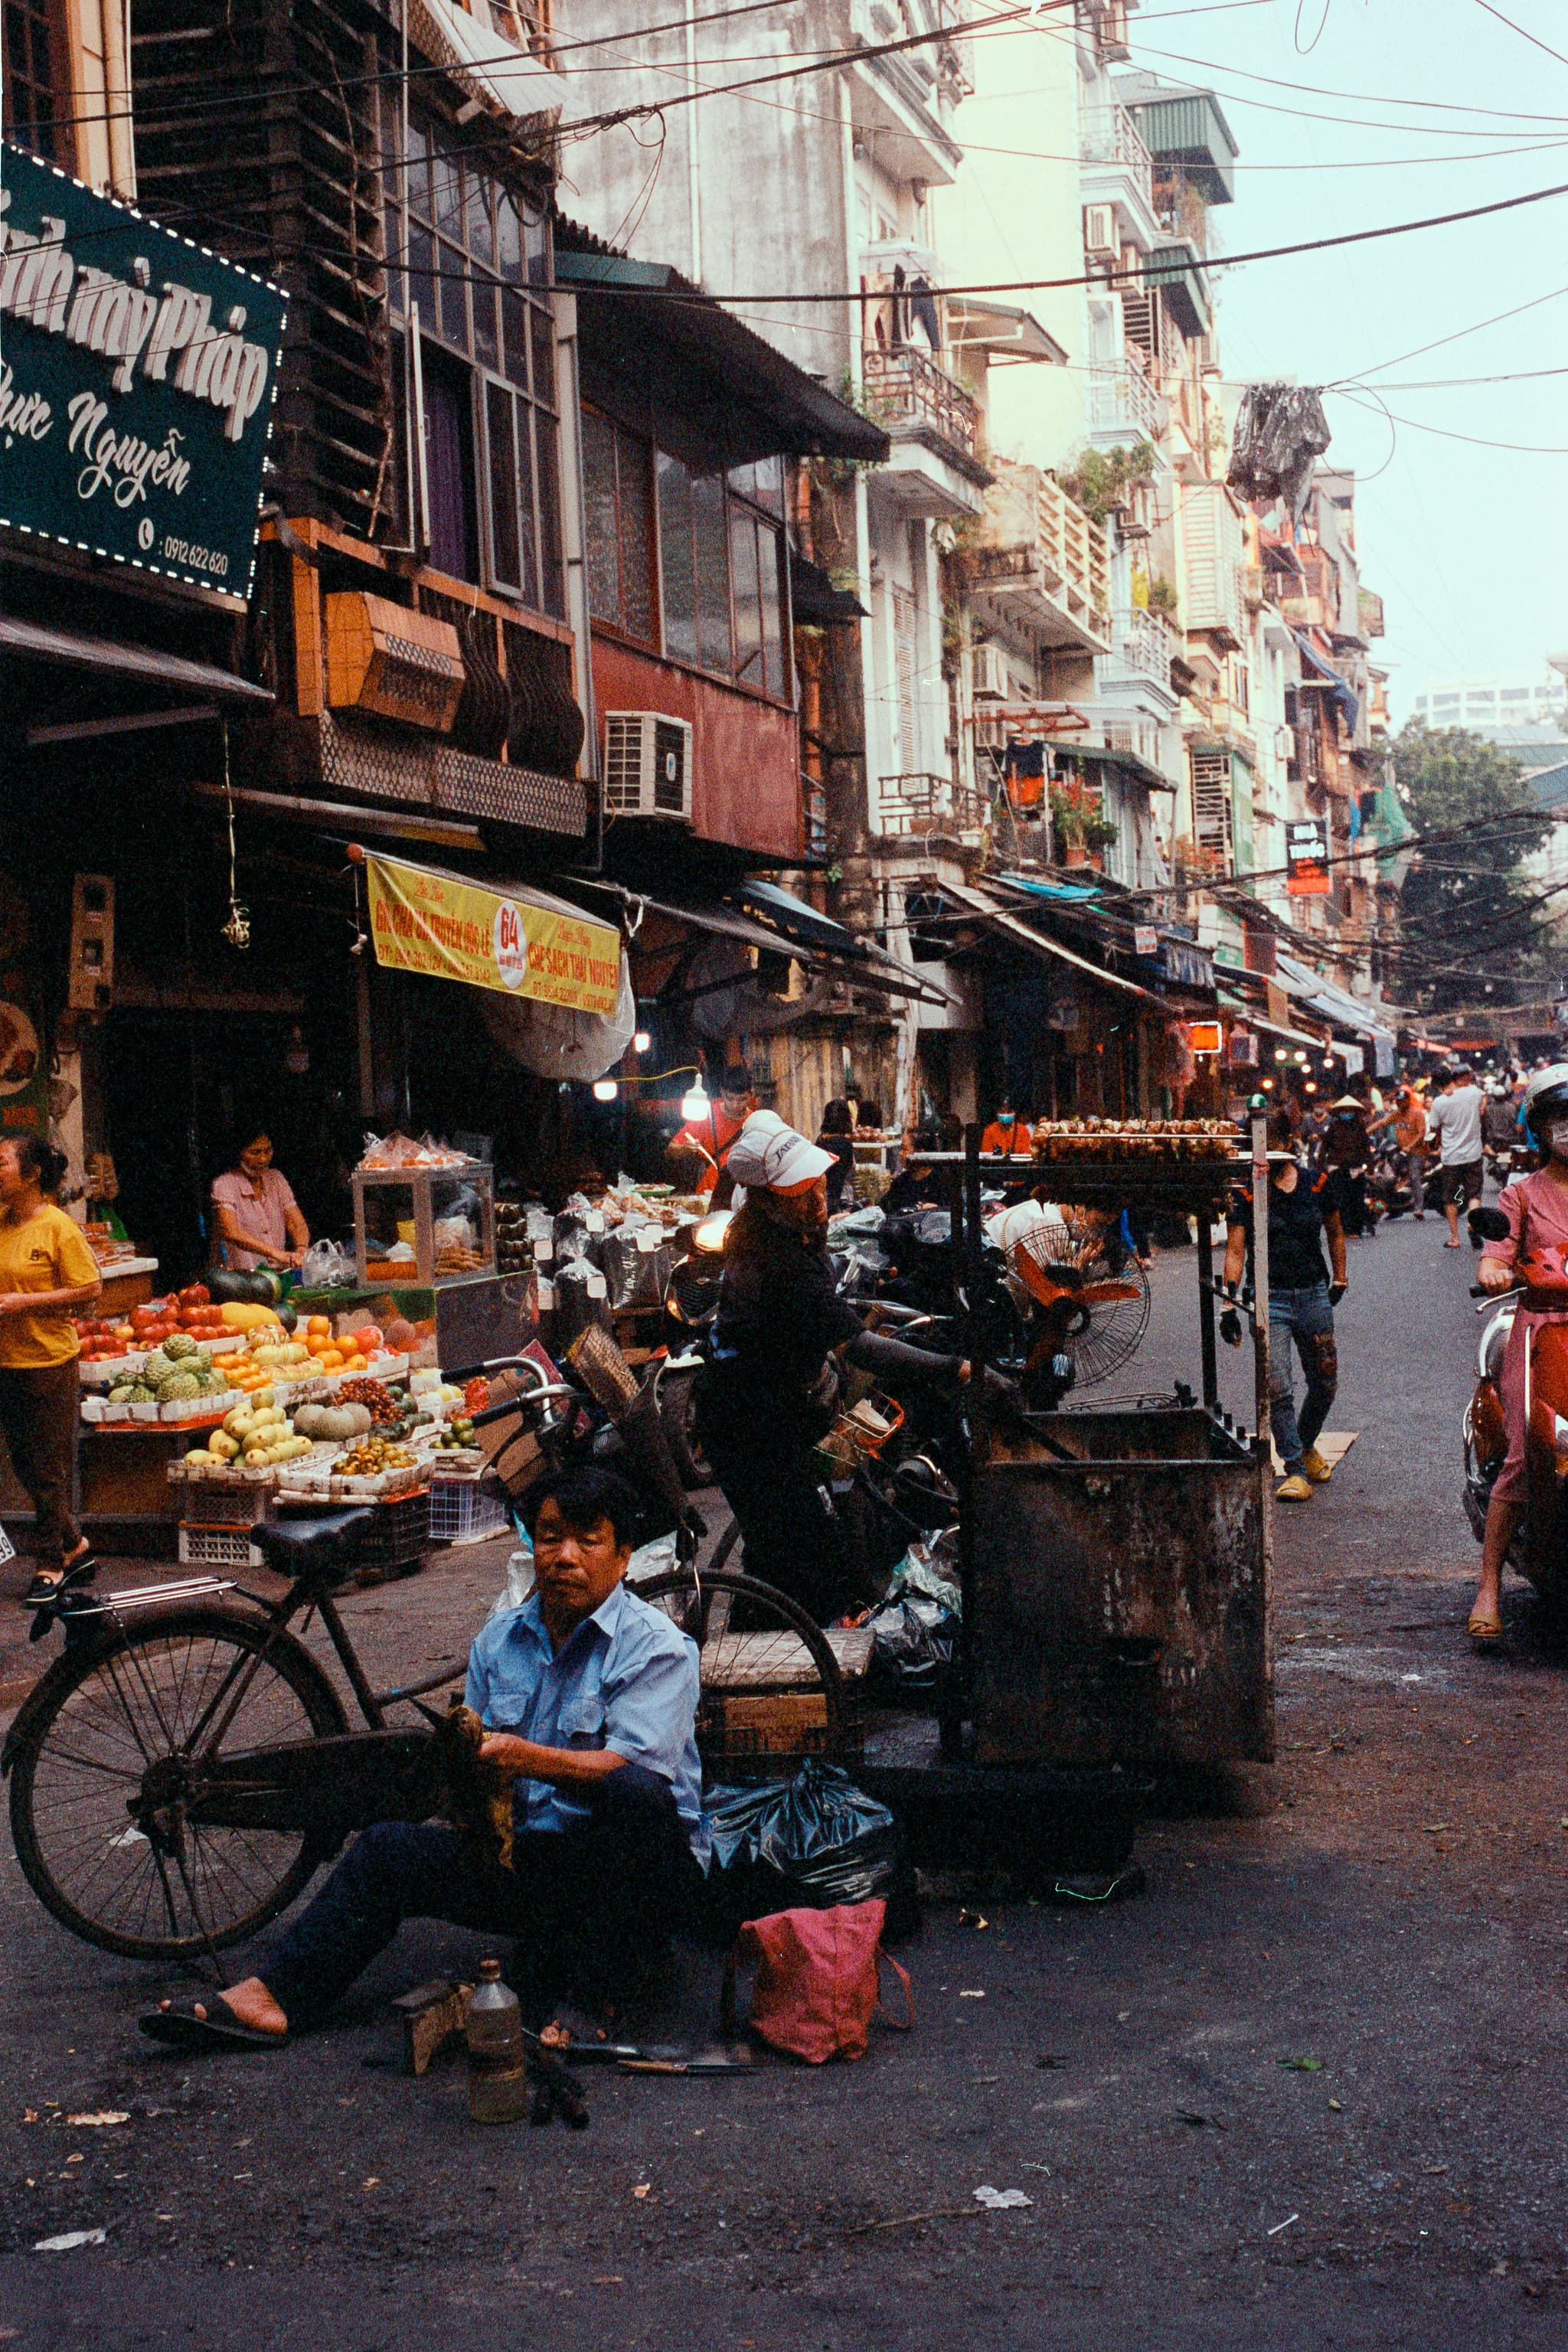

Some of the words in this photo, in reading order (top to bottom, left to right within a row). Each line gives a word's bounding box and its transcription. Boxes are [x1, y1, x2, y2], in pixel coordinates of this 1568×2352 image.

[144, 282, 268, 442] Pháp
[67, 391, 191, 508] Nguyễn
[165, 536, 188, 564] 0912
[188, 544, 209, 570] 622
[208, 551, 227, 576] 620
[501, 907, 518, 952] 64
